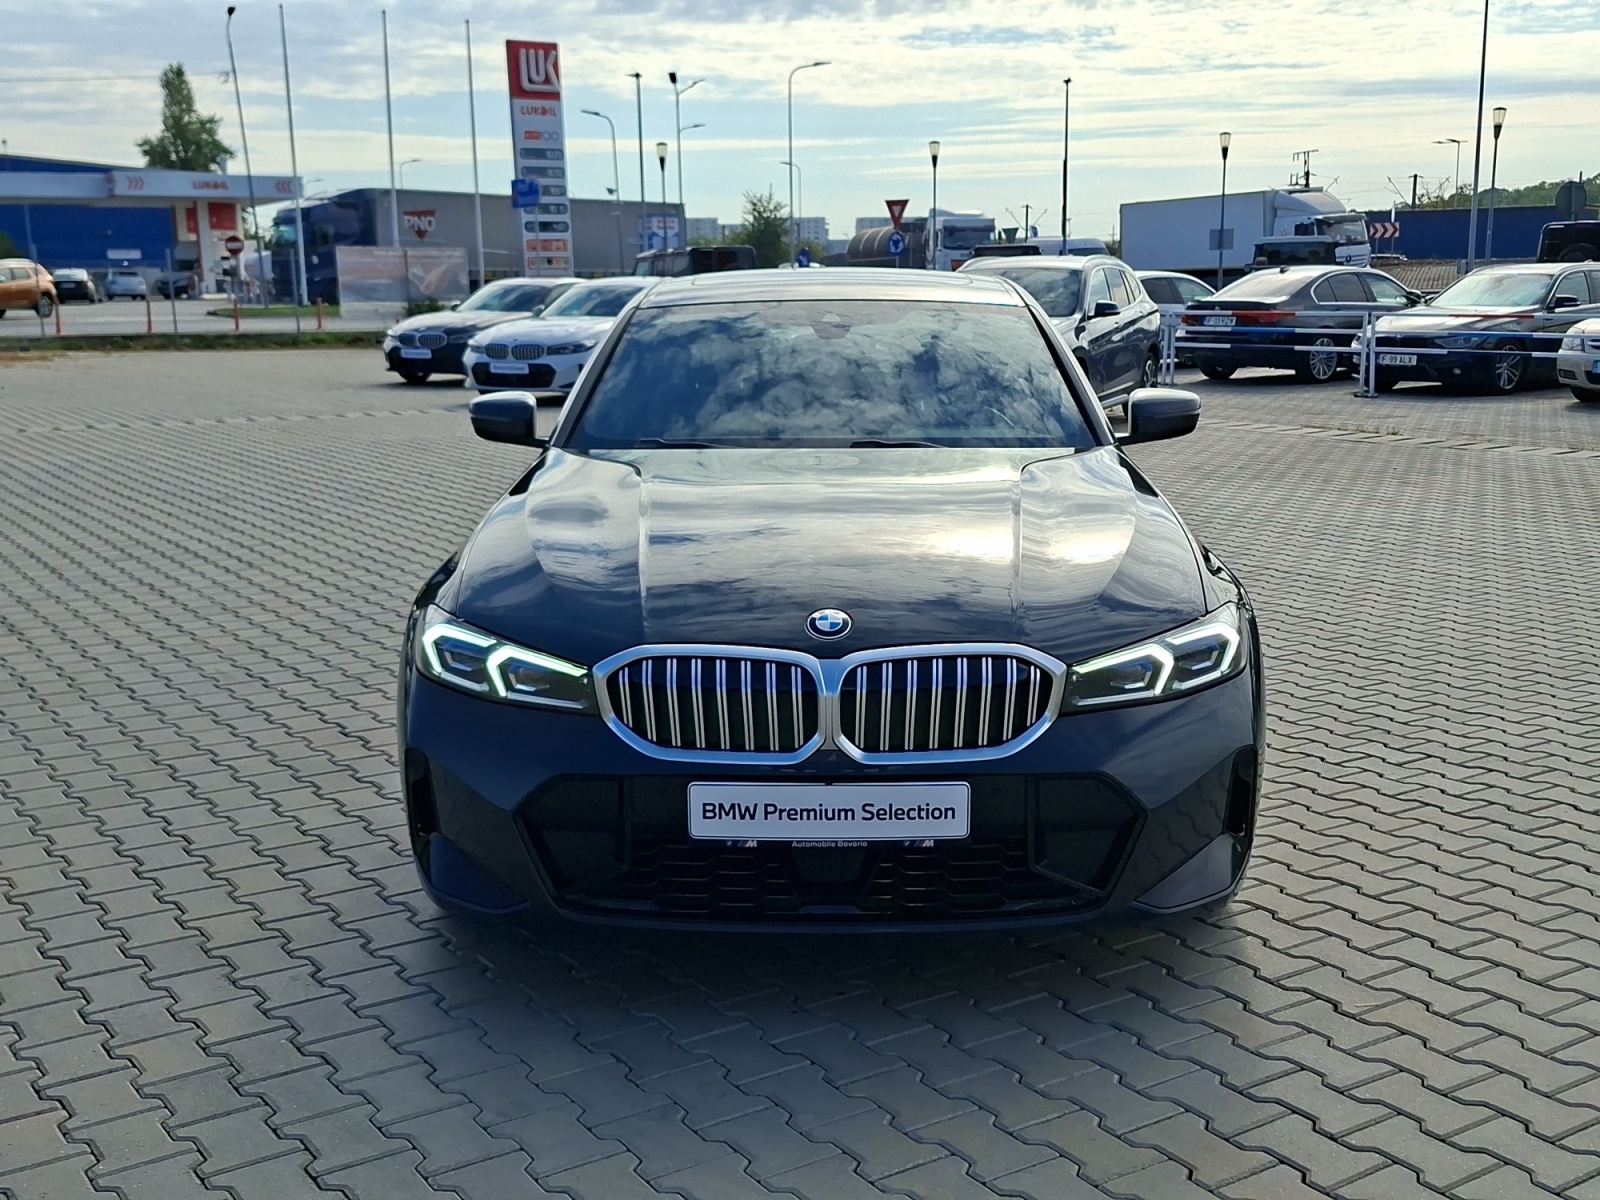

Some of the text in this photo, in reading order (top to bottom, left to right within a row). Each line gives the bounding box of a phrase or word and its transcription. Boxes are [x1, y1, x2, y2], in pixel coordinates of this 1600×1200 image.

[519, 48, 561, 93] LUK
[404, 215, 436, 232] PNO
[1389, 355, 1397, 364] 99
[702, 802, 956, 821] BMW Premium Selection
[791, 840, 868, 848] Automobile Bavaria
